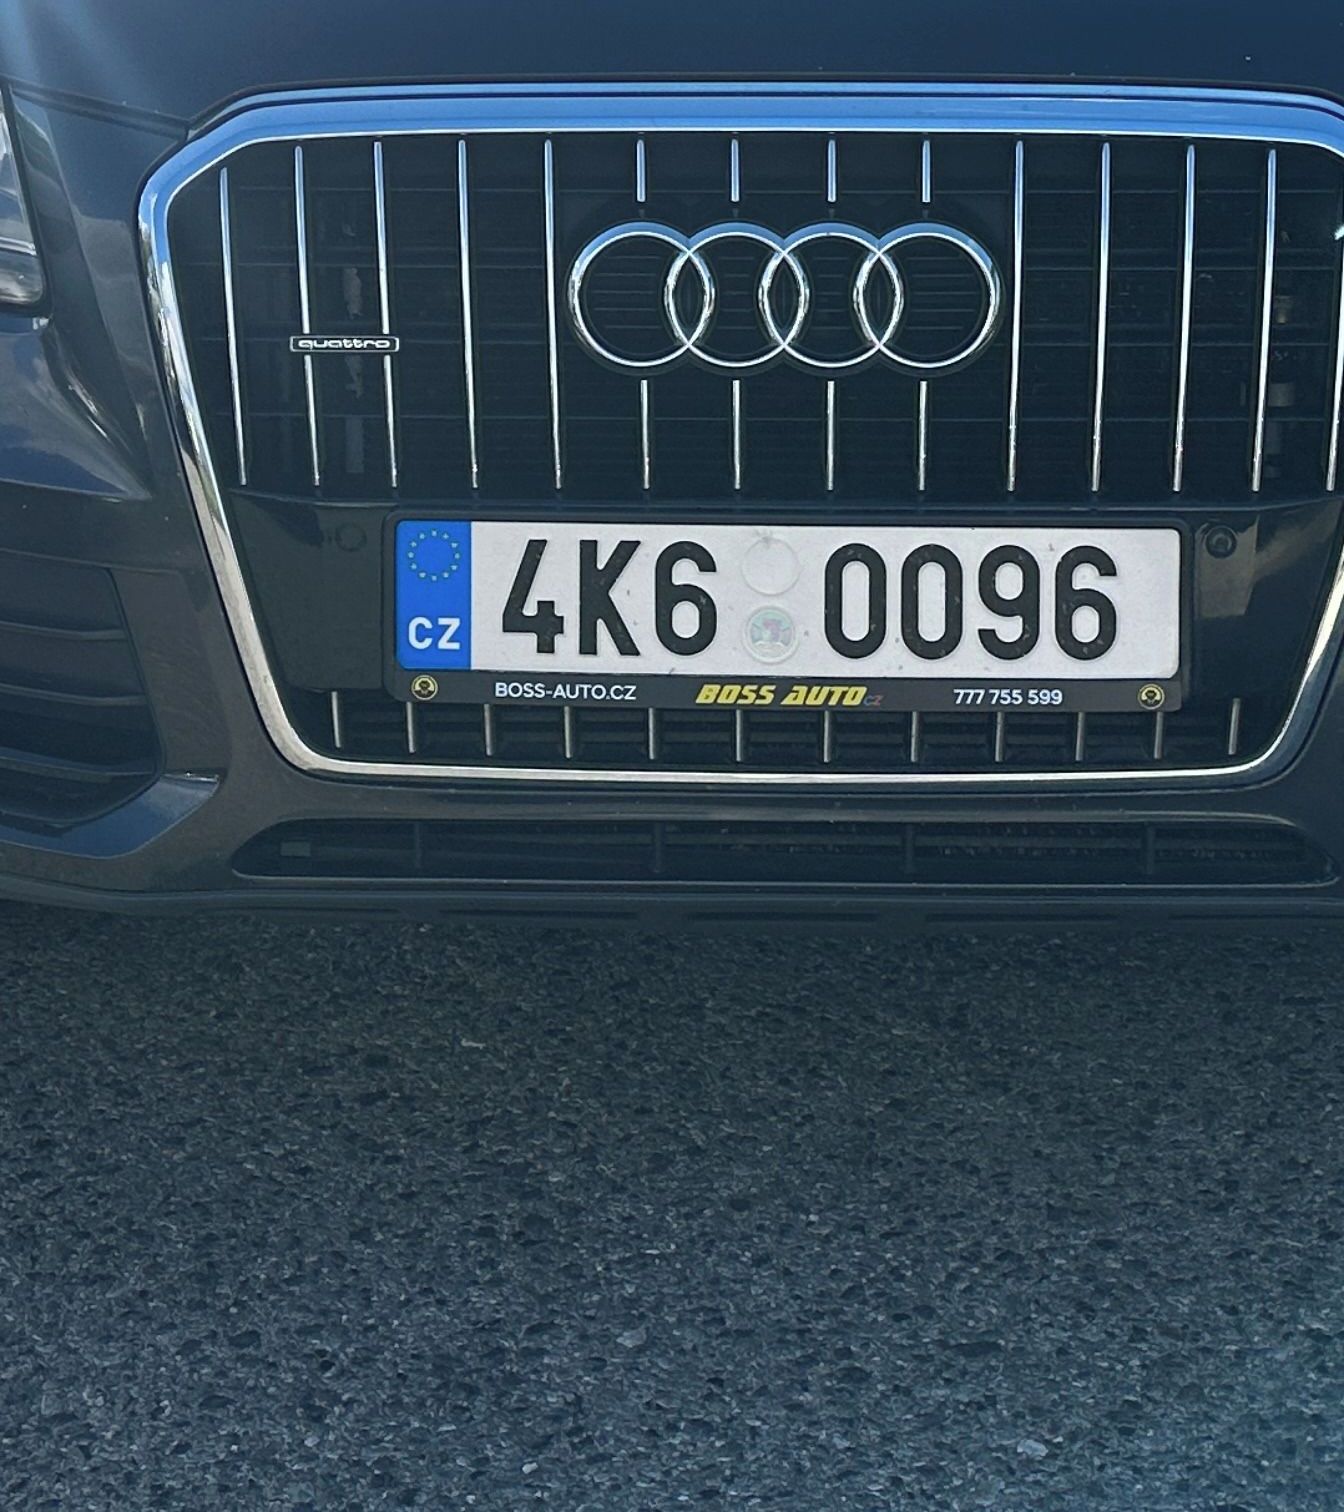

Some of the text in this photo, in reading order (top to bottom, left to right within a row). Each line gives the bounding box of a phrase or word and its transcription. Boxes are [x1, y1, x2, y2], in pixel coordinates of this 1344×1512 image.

[298, 338, 391, 350] quattro
[502, 539, 1118, 661] 4K6 0096
[408, 616, 461, 650] CZ
[494, 682, 637, 701] BOSS-AUTO.CZ
[695, 683, 775, 705] BOSS
[780, 685, 868, 707] AUTO
[953, 688, 1063, 705] 777 755 599
